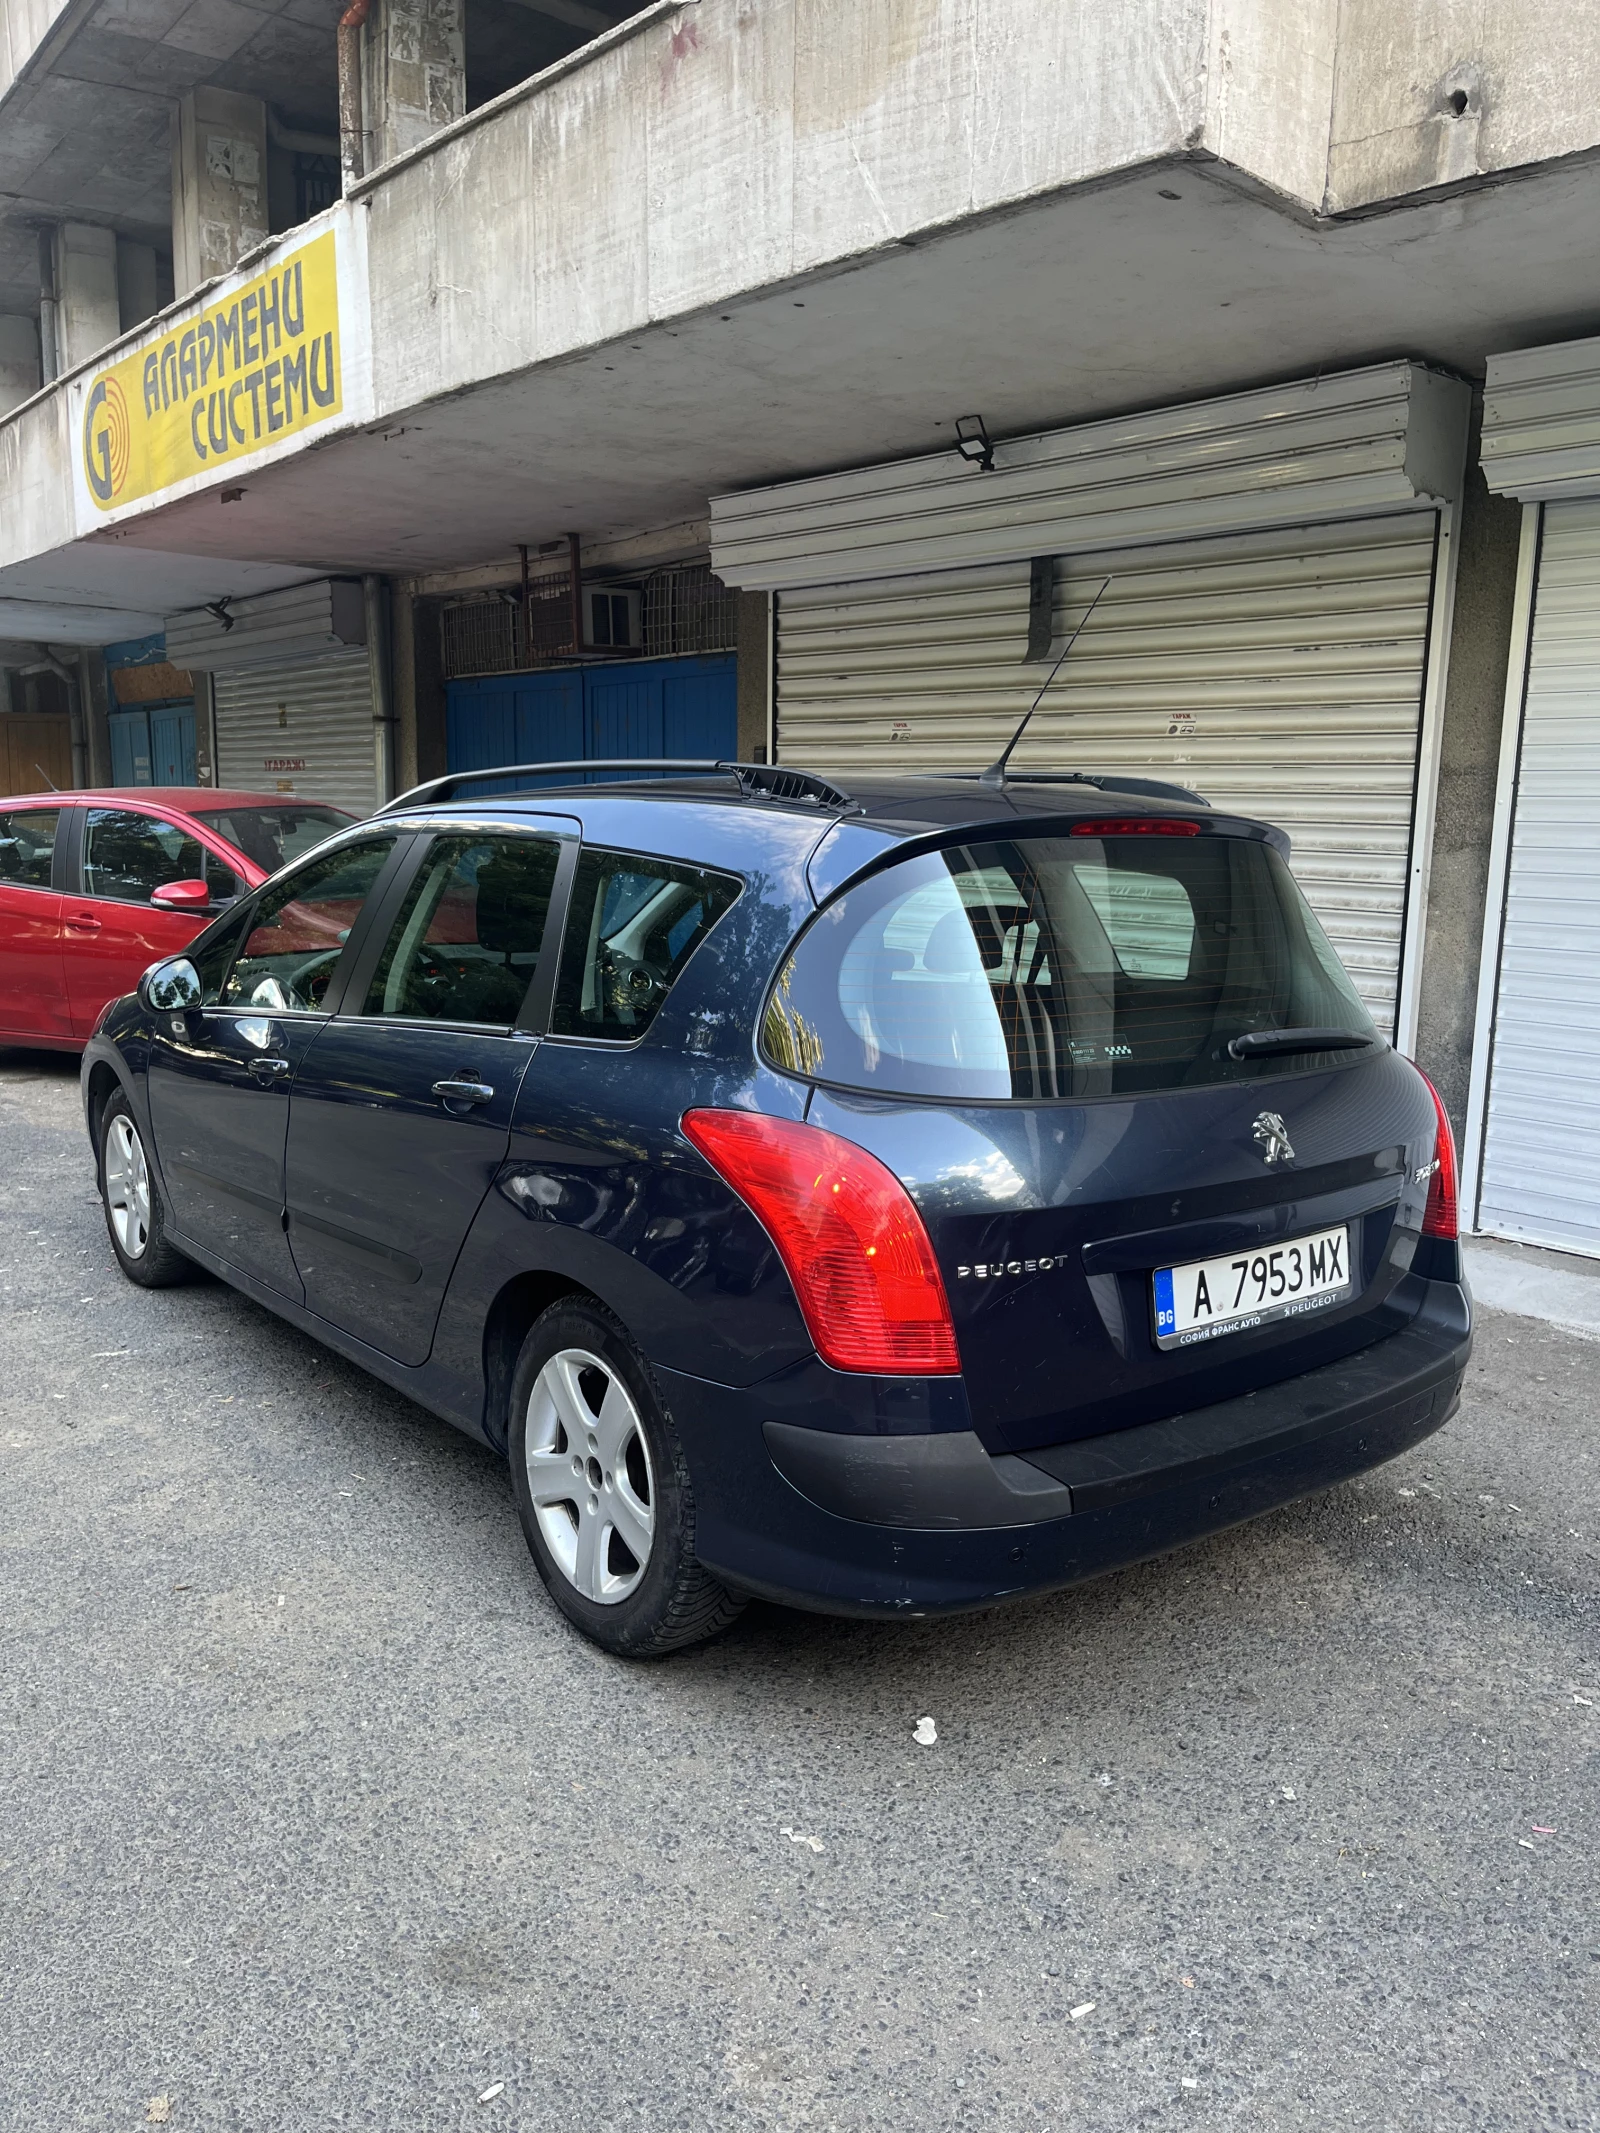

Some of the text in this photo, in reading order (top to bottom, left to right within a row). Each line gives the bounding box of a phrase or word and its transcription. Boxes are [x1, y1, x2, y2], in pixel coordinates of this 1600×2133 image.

[143, 260, 305, 420] АЛАРМЕНИ
[191, 331, 336, 460] СИСТЕМИ
[957, 1254, 1068, 1279] PEUGEOT
[1193, 1235, 1344, 1319] A 7953 MX
[1158, 1310, 1174, 1326] BG
[1291, 1293, 1338, 1316] PEUGEOT
[1179, 1315, 1262, 1345] СОФИЯ ФРАНС АУТО
